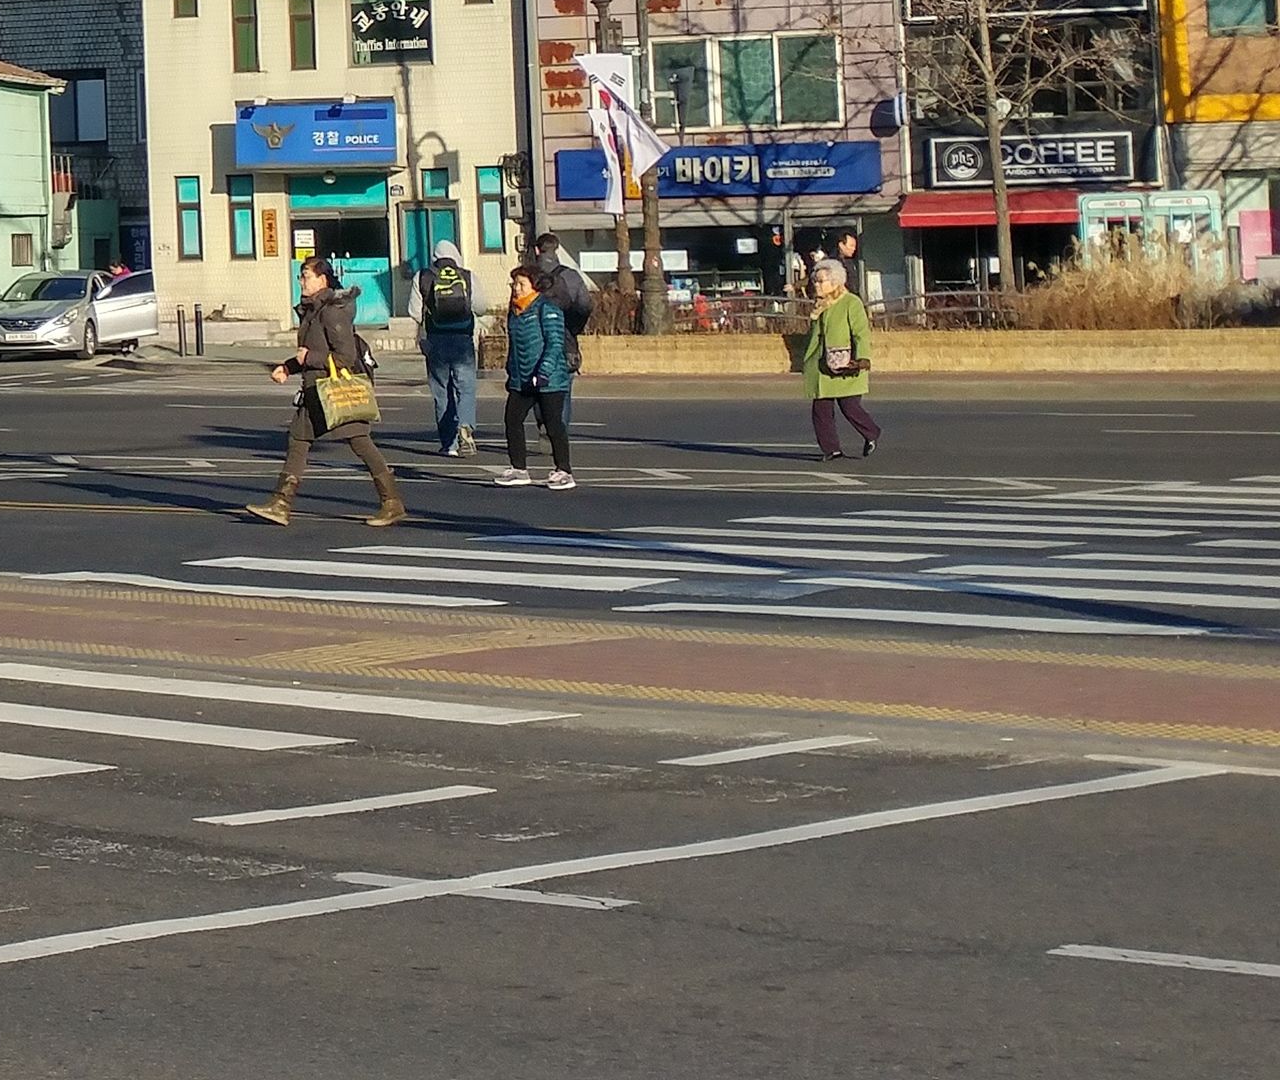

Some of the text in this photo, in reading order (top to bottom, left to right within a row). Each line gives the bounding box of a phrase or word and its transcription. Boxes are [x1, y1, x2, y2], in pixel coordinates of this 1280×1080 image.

[352, 0, 429, 33] 교통안내
[312, 130, 380, 146] 경찰 POLICE
[1000, 140, 1117, 165] COFFEE
[675, 154, 761, 185] 바이키
